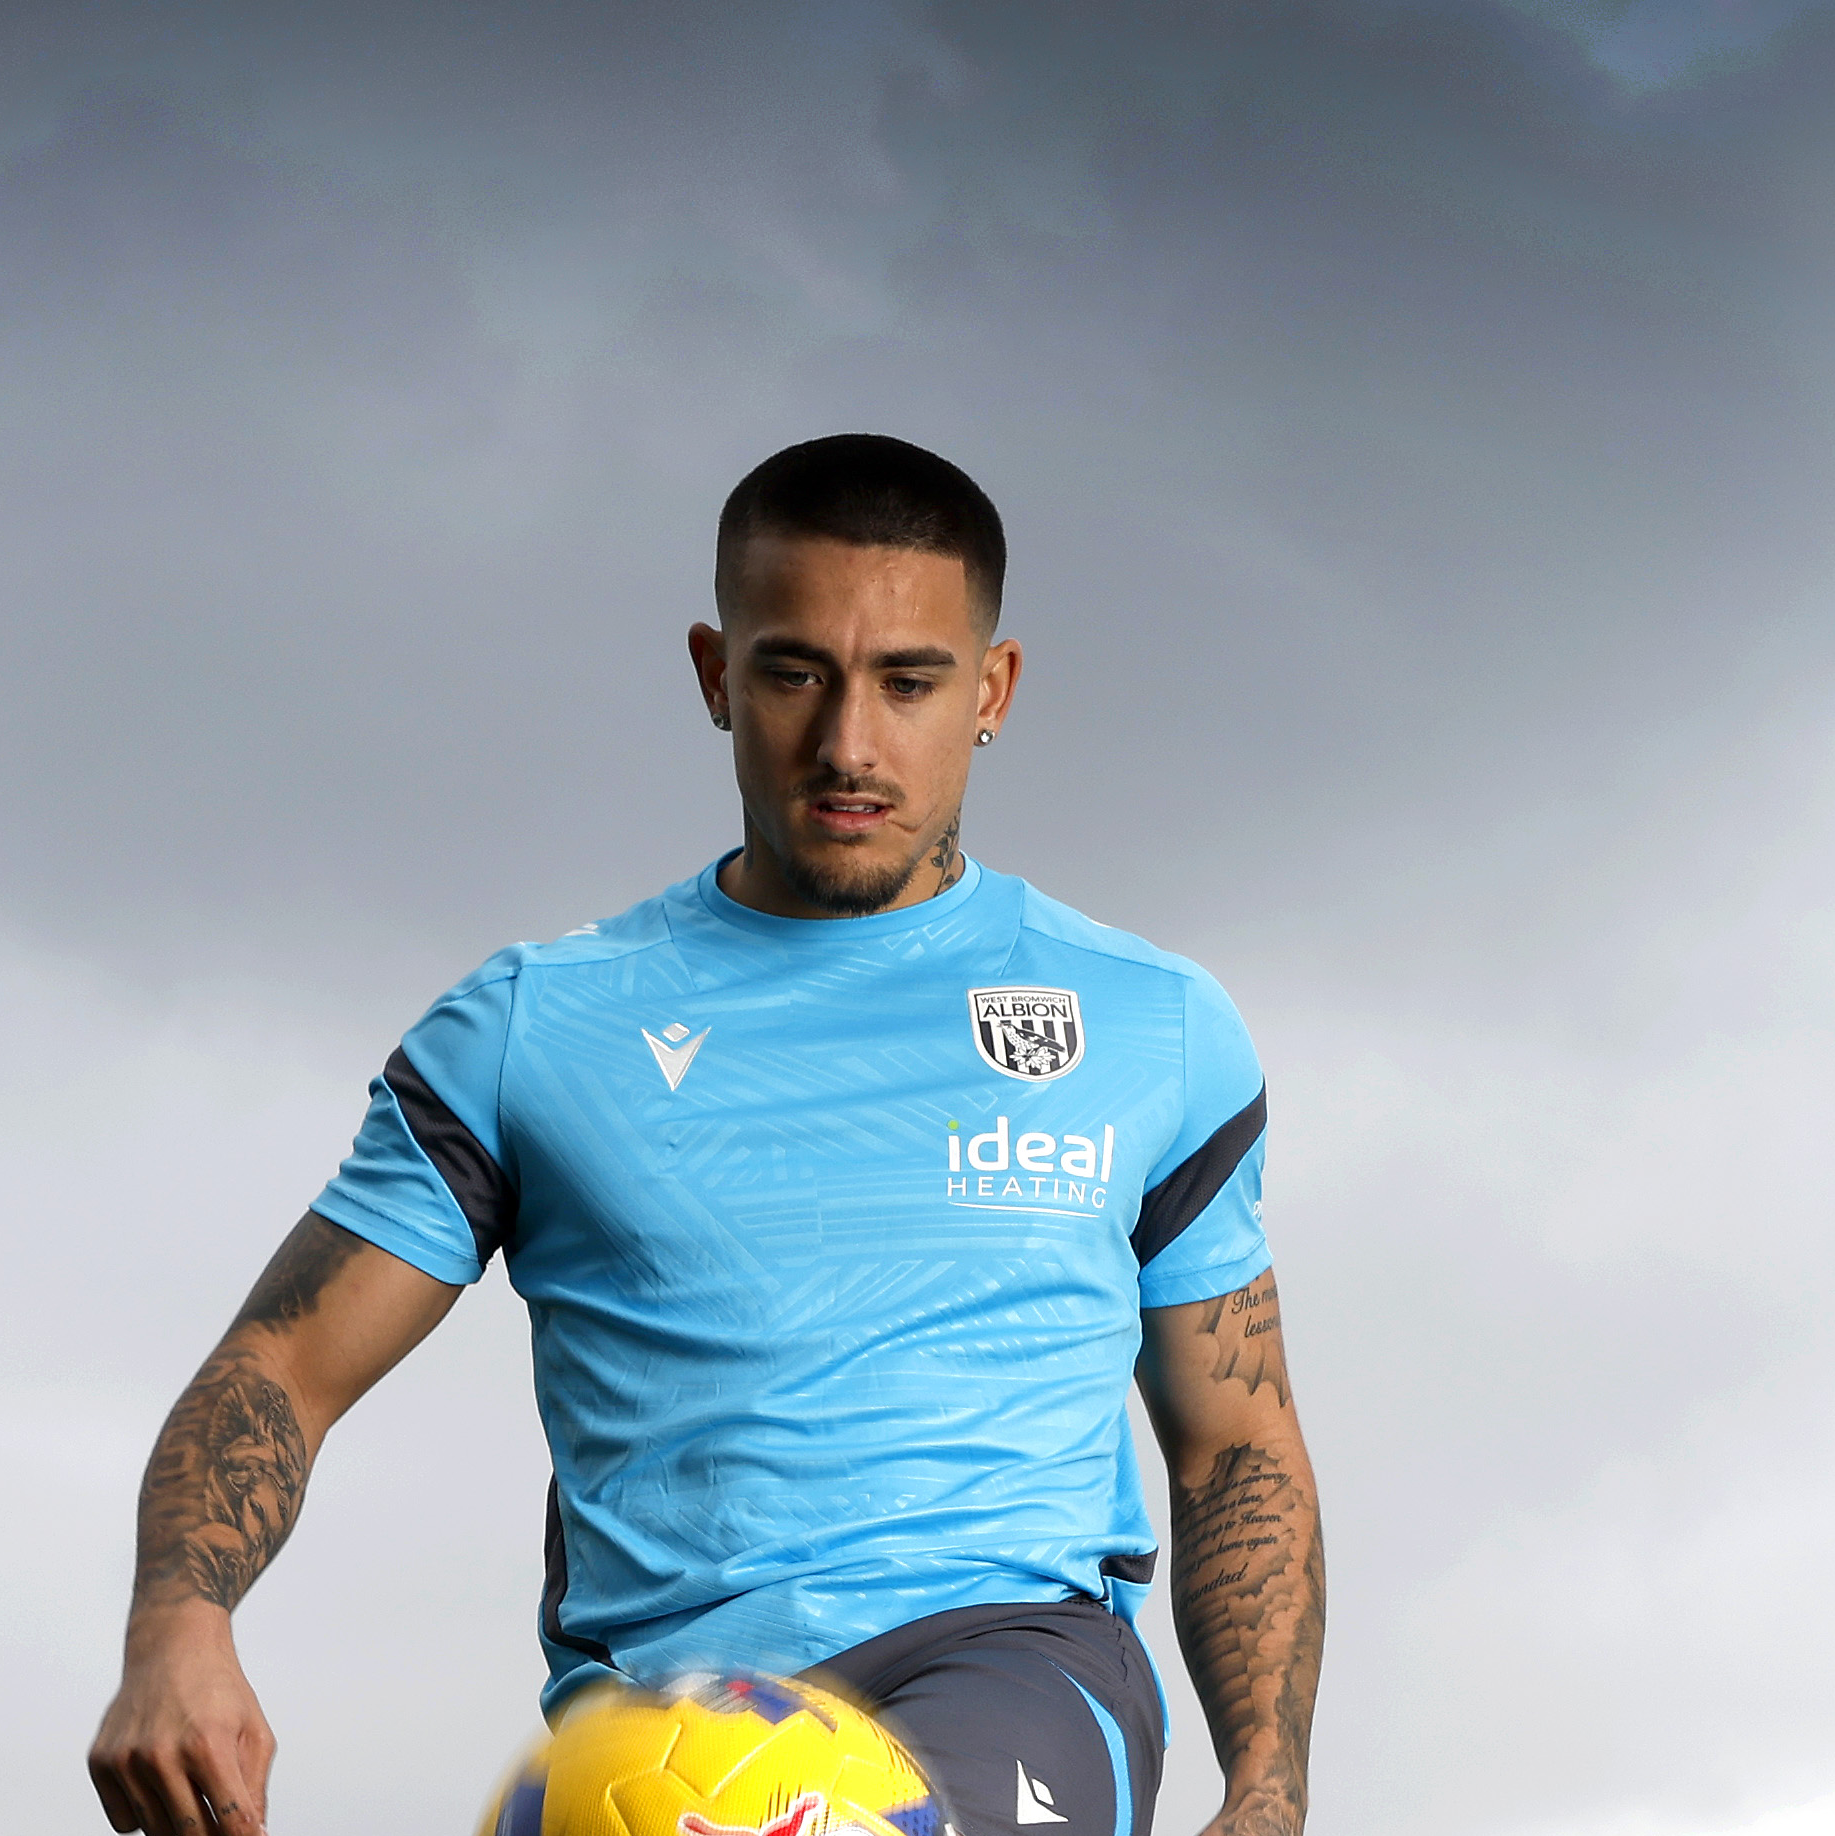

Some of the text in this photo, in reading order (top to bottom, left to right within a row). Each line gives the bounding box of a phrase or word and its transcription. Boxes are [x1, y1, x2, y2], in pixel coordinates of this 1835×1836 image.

[980, 995, 1066, 1004] WEST BROMWICH
[983, 1003, 1068, 1018] ALBION
[947, 1116, 1114, 1183] ideal
[947, 1176, 1107, 1209] HEATING
[1231, 1287, 1260, 1314] The
